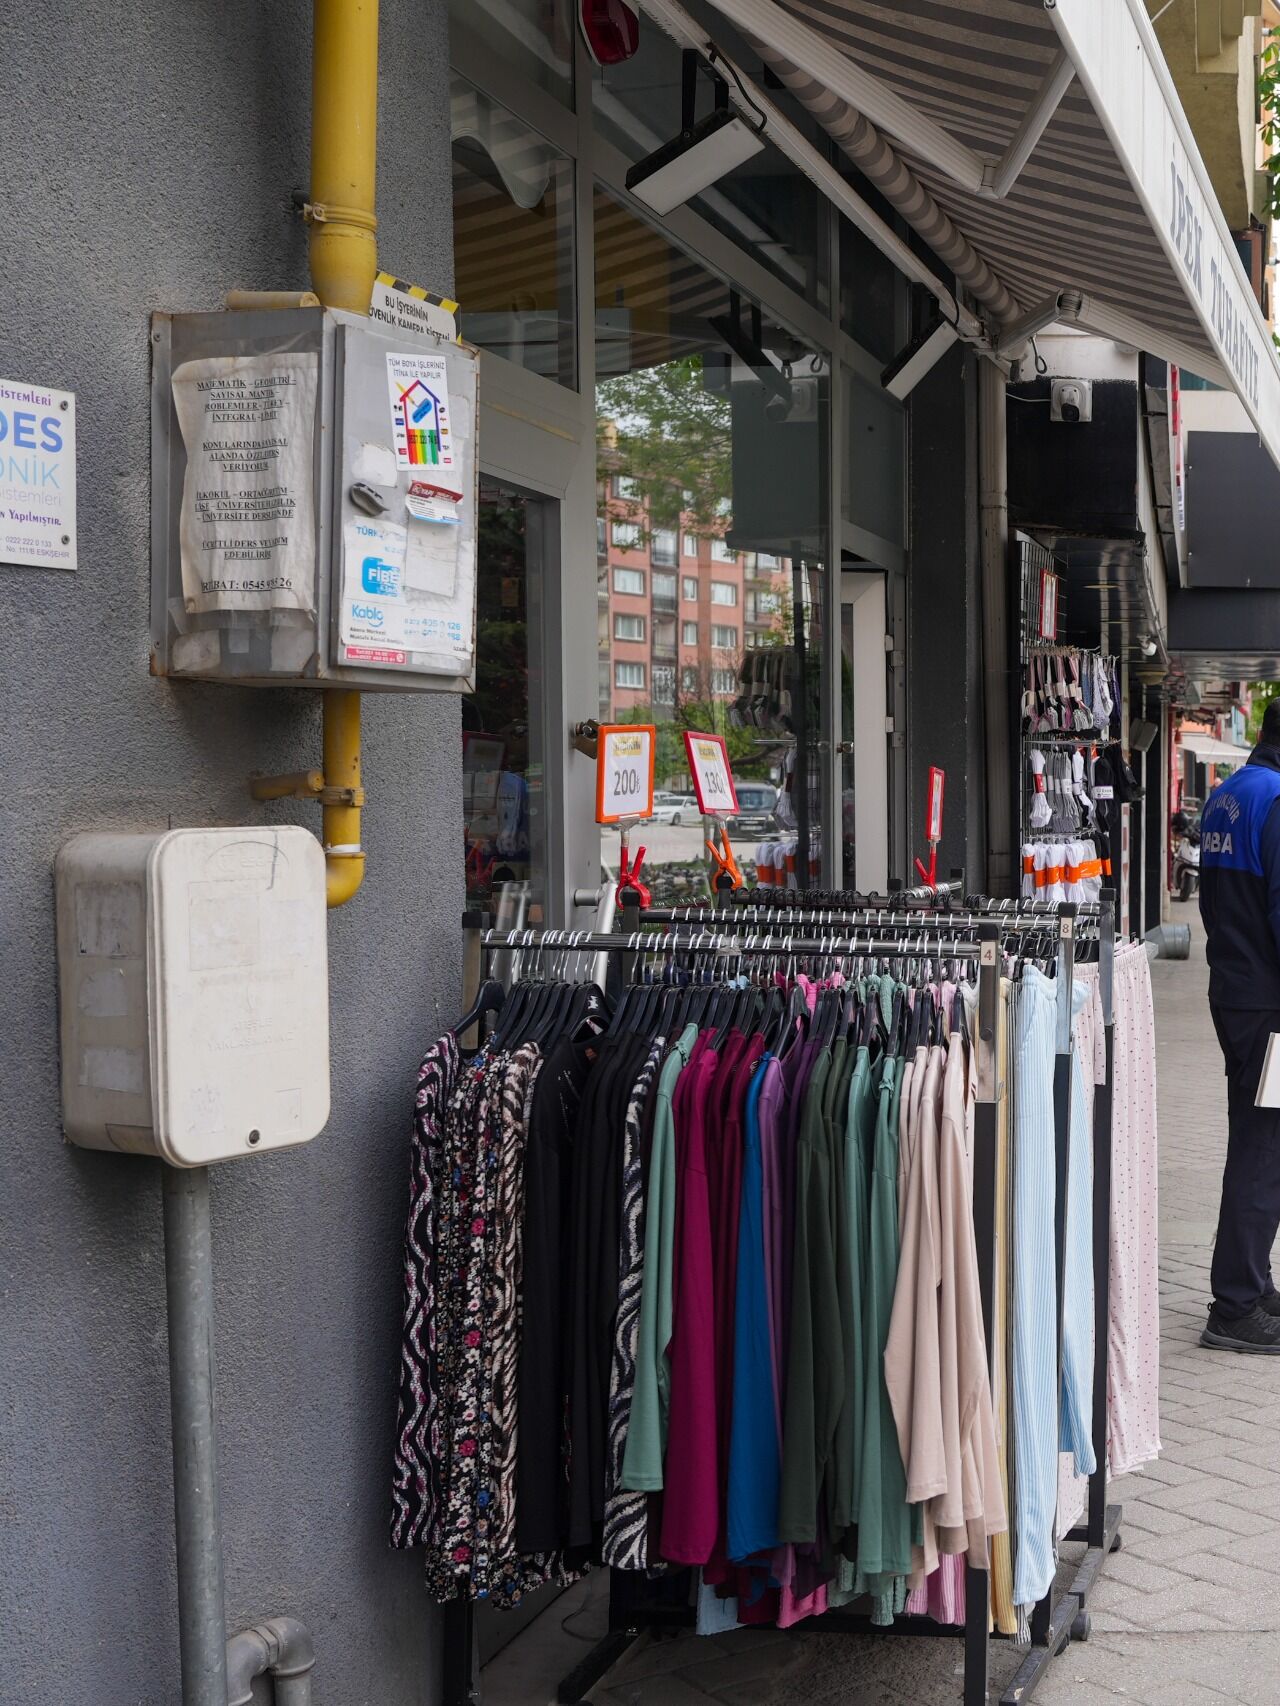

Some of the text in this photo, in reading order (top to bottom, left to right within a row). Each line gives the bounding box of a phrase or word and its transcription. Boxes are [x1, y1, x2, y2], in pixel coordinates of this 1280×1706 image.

[1170, 142, 1259, 411] İPEK TUHAFİYE
[385, 295, 429, 322] BU İŞYERİNİN
[369, 307, 397, 326] ÜVENLİK
[388, 358, 445, 370] TÜM BOYA İŞLERİNİZ
[420, 371, 441, 380] YAPILIR
[197, 378, 246, 390] MATEMATİK
[0, 385, 51, 406] İSTEMLERİ
[211, 391, 245, 400] SAYISAL
[209, 452, 244, 461] ALANDA
[0, 455, 61, 489] NİK
[0, 487, 62, 507] istemleri
[196, 490, 231, 500] İLKOKUL
[5, 536, 21, 544] 0222
[22, 538, 34, 546] 222
[234, 540, 258, 549] DERS
[352, 604, 384, 621] Kablo
[1062, 923, 1070, 934] 8
[983, 949, 993, 961] 4
